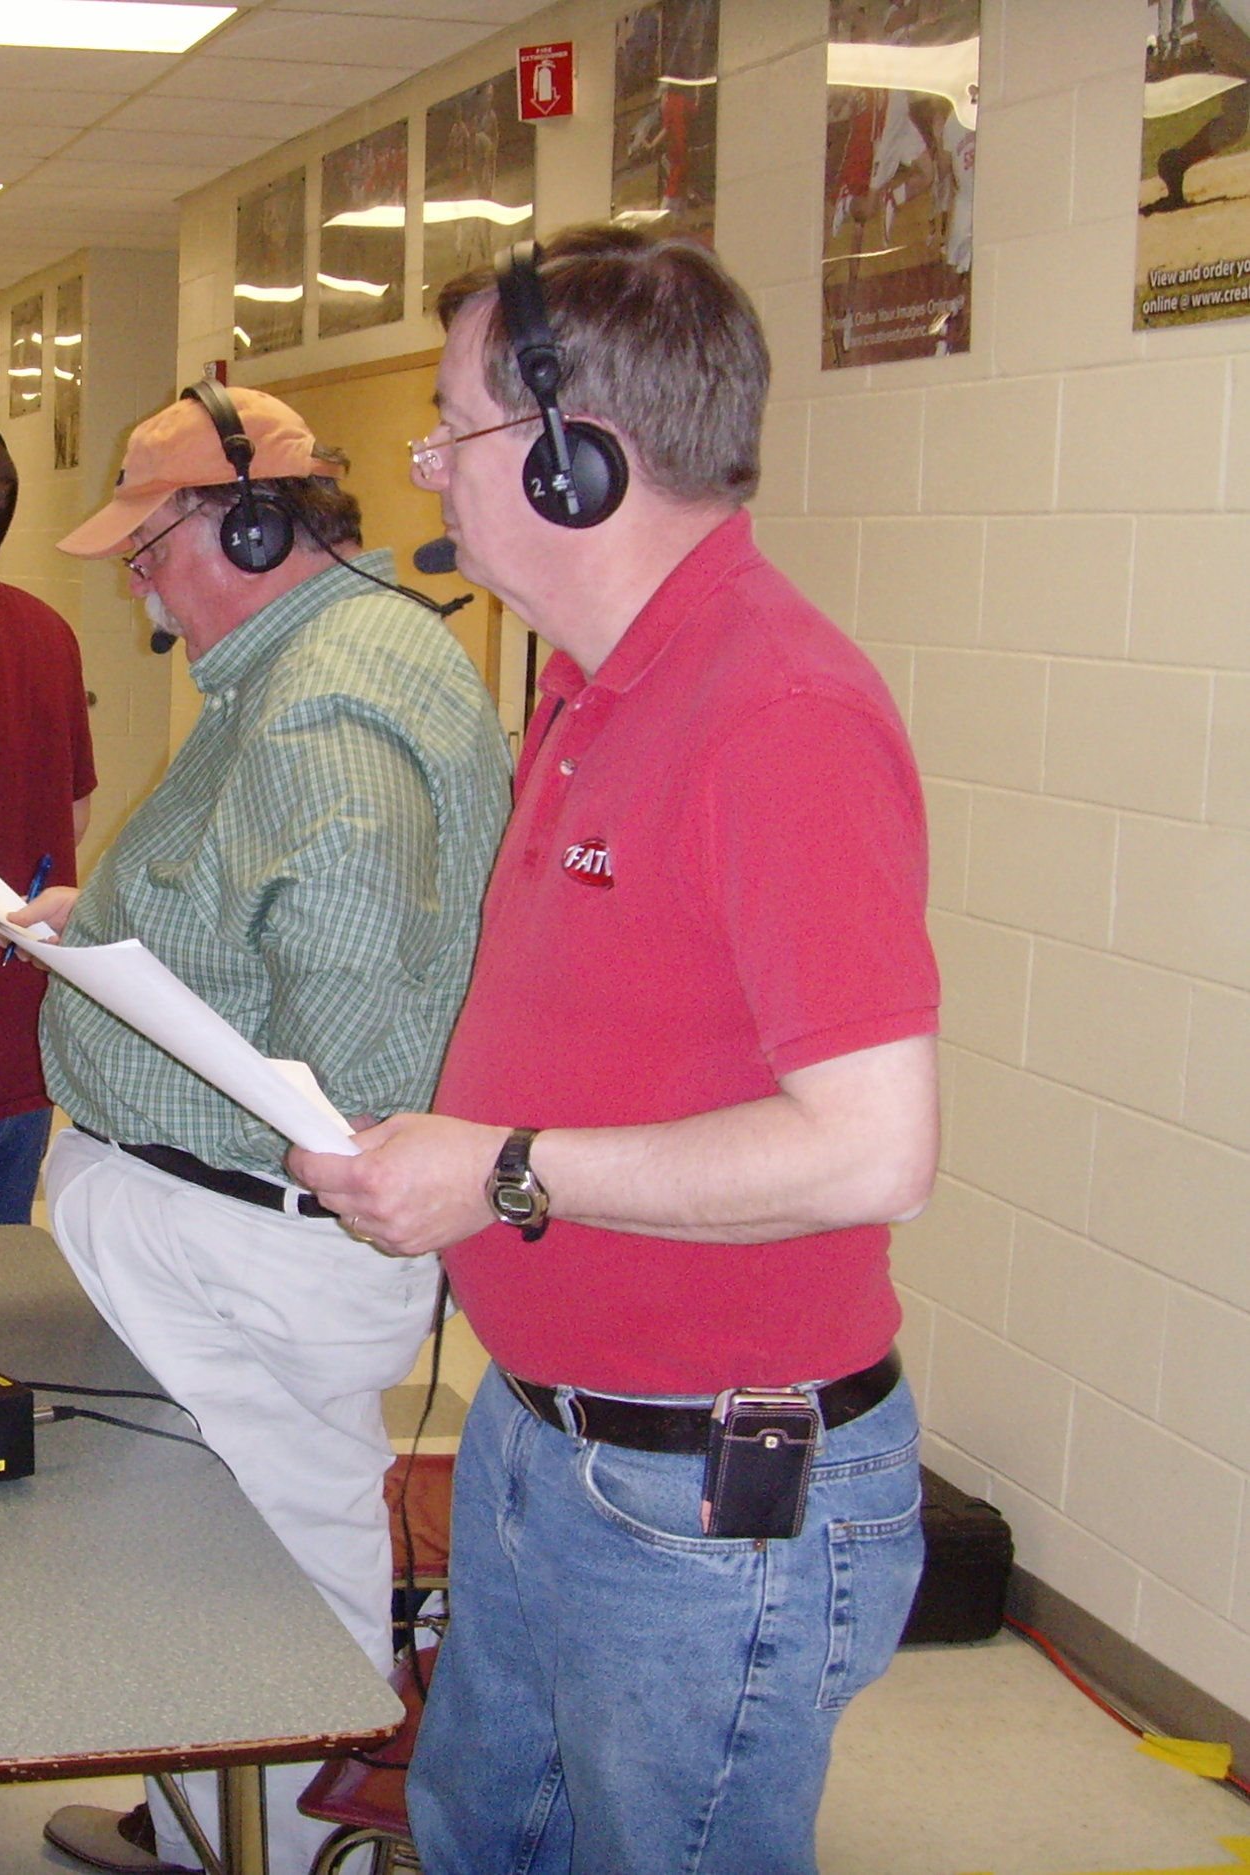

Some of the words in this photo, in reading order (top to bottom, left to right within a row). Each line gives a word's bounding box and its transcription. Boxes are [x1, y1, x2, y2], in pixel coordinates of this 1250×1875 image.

[1150, 270, 1178, 287] View
[1178, 264, 1200, 283] and
[1202, 260, 1235, 277] order
[1142, 296, 1178, 314] online
[1179, 295, 1190, 311] @
[531, 478, 546, 498] 2
[232, 532, 241, 546] 1
